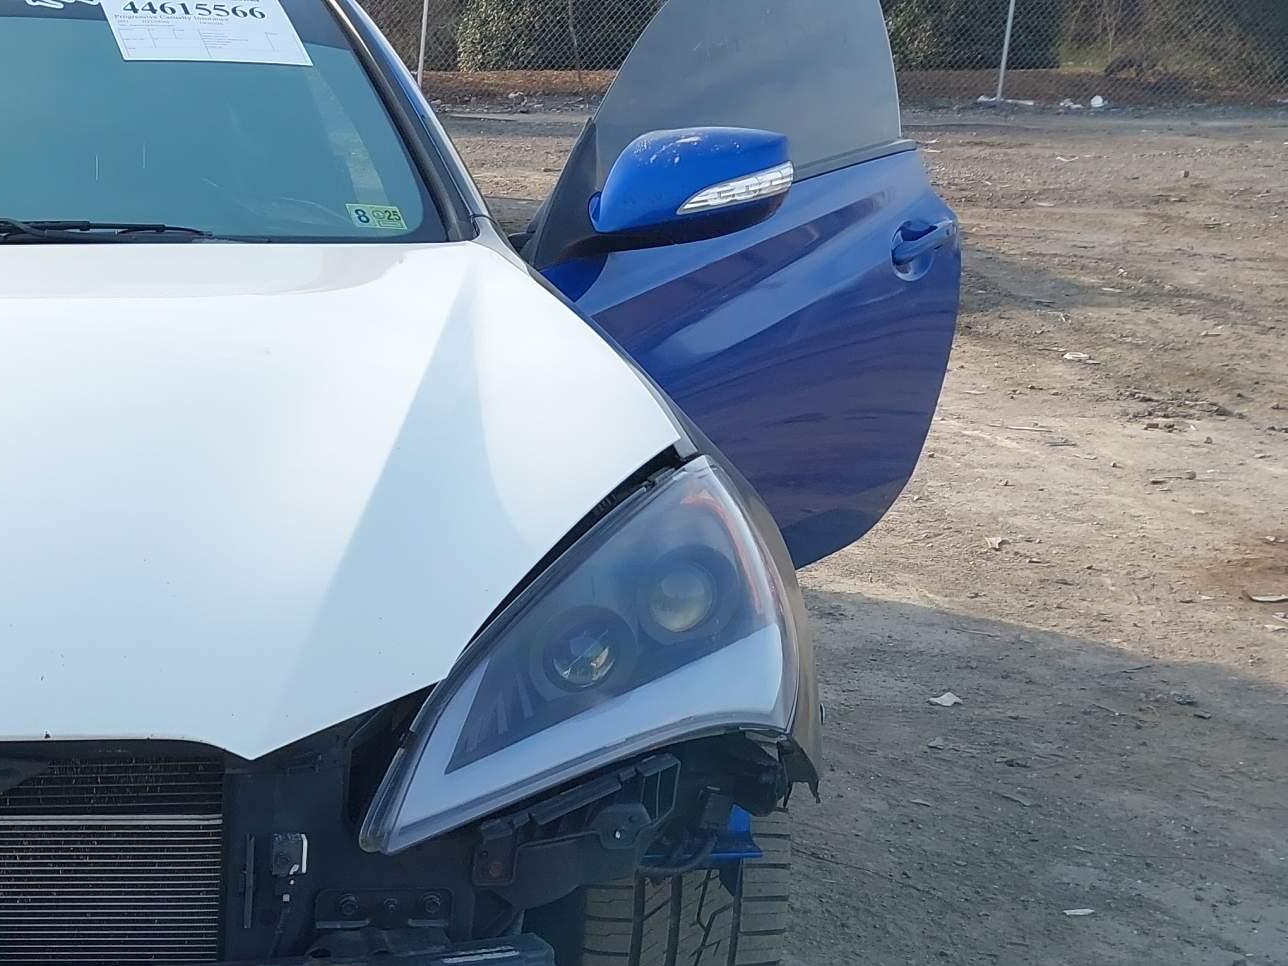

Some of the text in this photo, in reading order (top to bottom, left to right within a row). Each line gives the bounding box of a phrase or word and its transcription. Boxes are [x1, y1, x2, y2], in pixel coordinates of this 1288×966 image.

[123, 1, 266, 19] 44615566
[355, 209, 401, 223] 8 25
